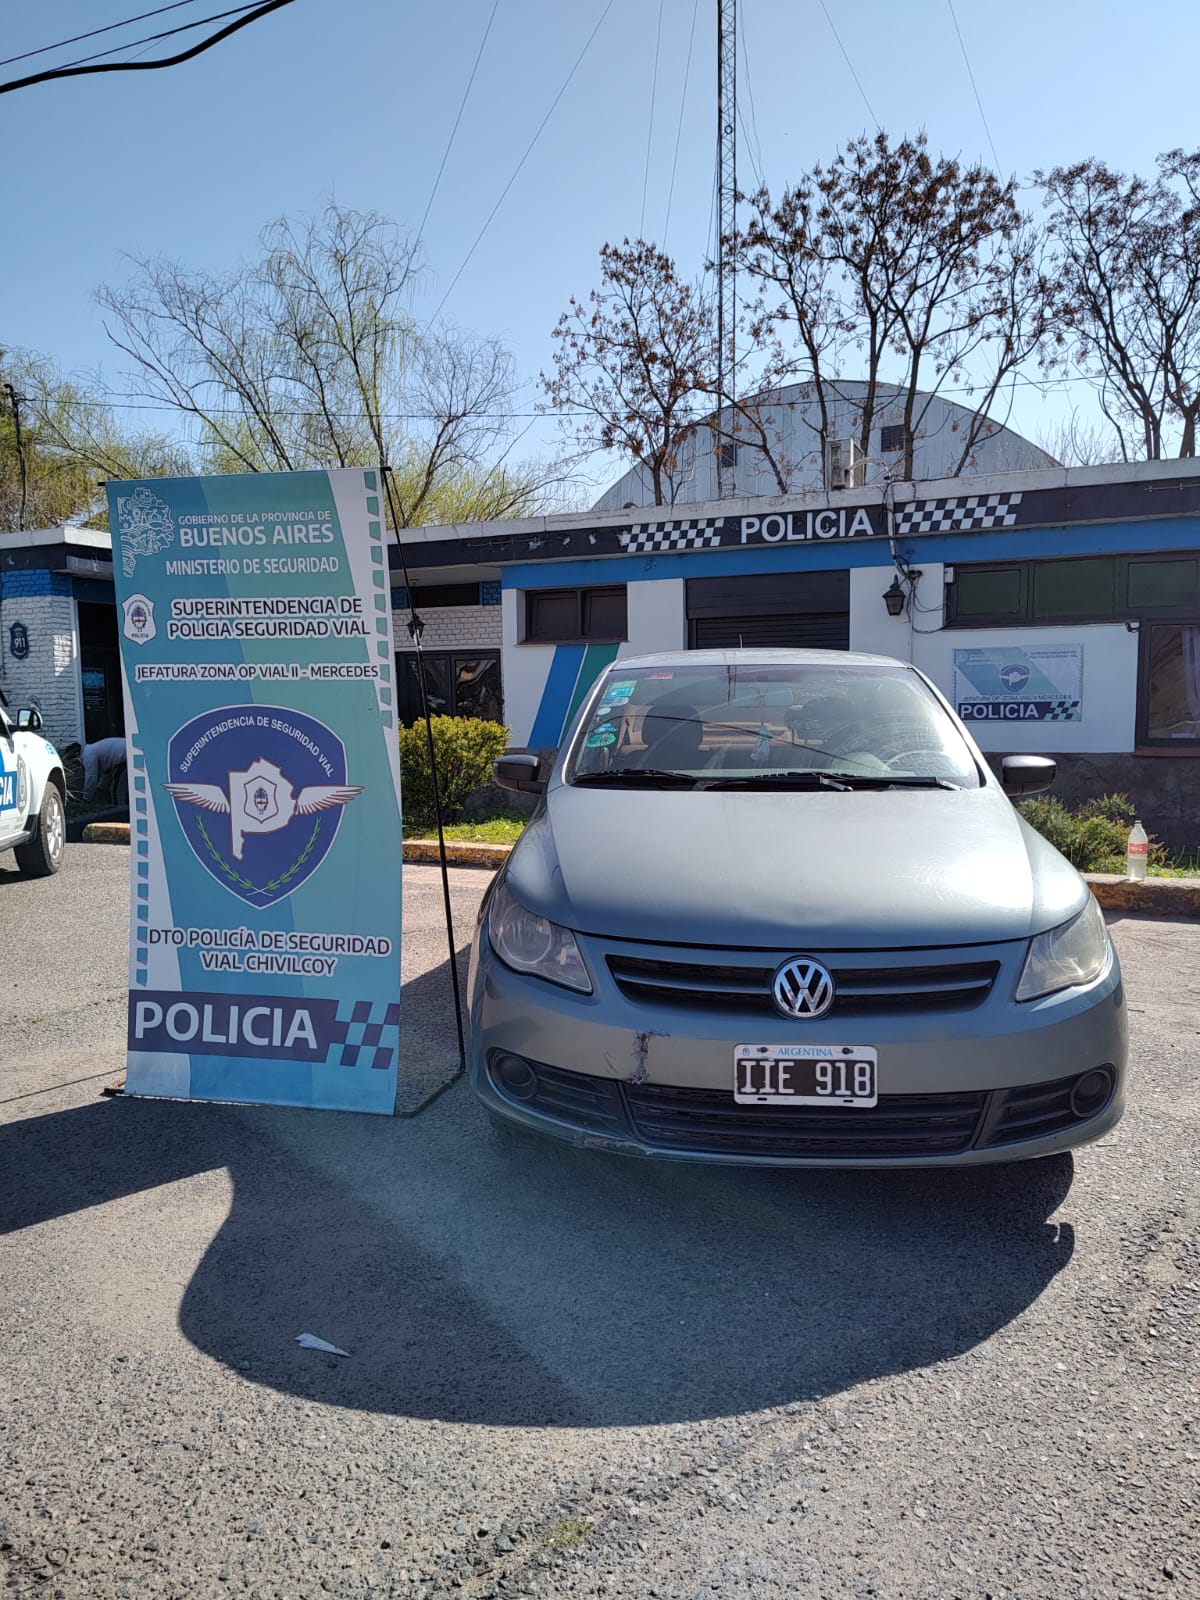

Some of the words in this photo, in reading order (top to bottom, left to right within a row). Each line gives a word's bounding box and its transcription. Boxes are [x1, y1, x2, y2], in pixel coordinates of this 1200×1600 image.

[178, 512, 229, 525] GOBIERNO
[231, 512, 245, 523] DE
[247, 512, 259, 523] LA
[261, 511, 316, 522] PROVINCIA
[318, 510, 331, 521] DE
[740, 508, 874, 544] POLICIA
[179, 525, 267, 548] BUENOS
[273, 523, 334, 544] AIRES
[166, 559, 241, 576] MINISTERIO
[243, 558, 259, 574] DE
[263, 556, 339, 574] SEGURIDAD
[173, 599, 336, 617] SUPERINTENDENCIA
[340, 598, 362, 614] DE
[170, 621, 236, 637] POLICIA
[236, 620, 330, 637] SEGURIDAD
[333, 620, 371, 635] VIAL
[14, 637, 26, 648] 911
[137, 666, 198, 681] JEFATURA
[200, 666, 235, 678] ZONA
[239, 666, 256, 678] OP
[260, 666, 289, 678] VIAL
[292, 666, 299, 677] II
[311, 665, 379, 678] MERCEDES
[960, 704, 1039, 719] POLICIA
[180, 715, 255, 773] SUPERINTENDENCIA
[257, 716, 270, 727] DE
[270, 718, 320, 756] SEGURIDAD
[318, 753, 334, 778] VIAL
[150, 929, 184, 945] DTO
[190, 927, 256, 949] POLICÍA
[262, 933, 284, 950] DE
[288, 934, 390, 955] SEGURIDAD
[202, 954, 242, 970] VIAL
[246, 955, 336, 976] CHIVILCOY
[135, 1001, 318, 1049] POLICIA
[777, 1047, 833, 1057] ARGENTINA
[740, 1061, 795, 1094] IIE
[815, 1062, 871, 1096] 918
